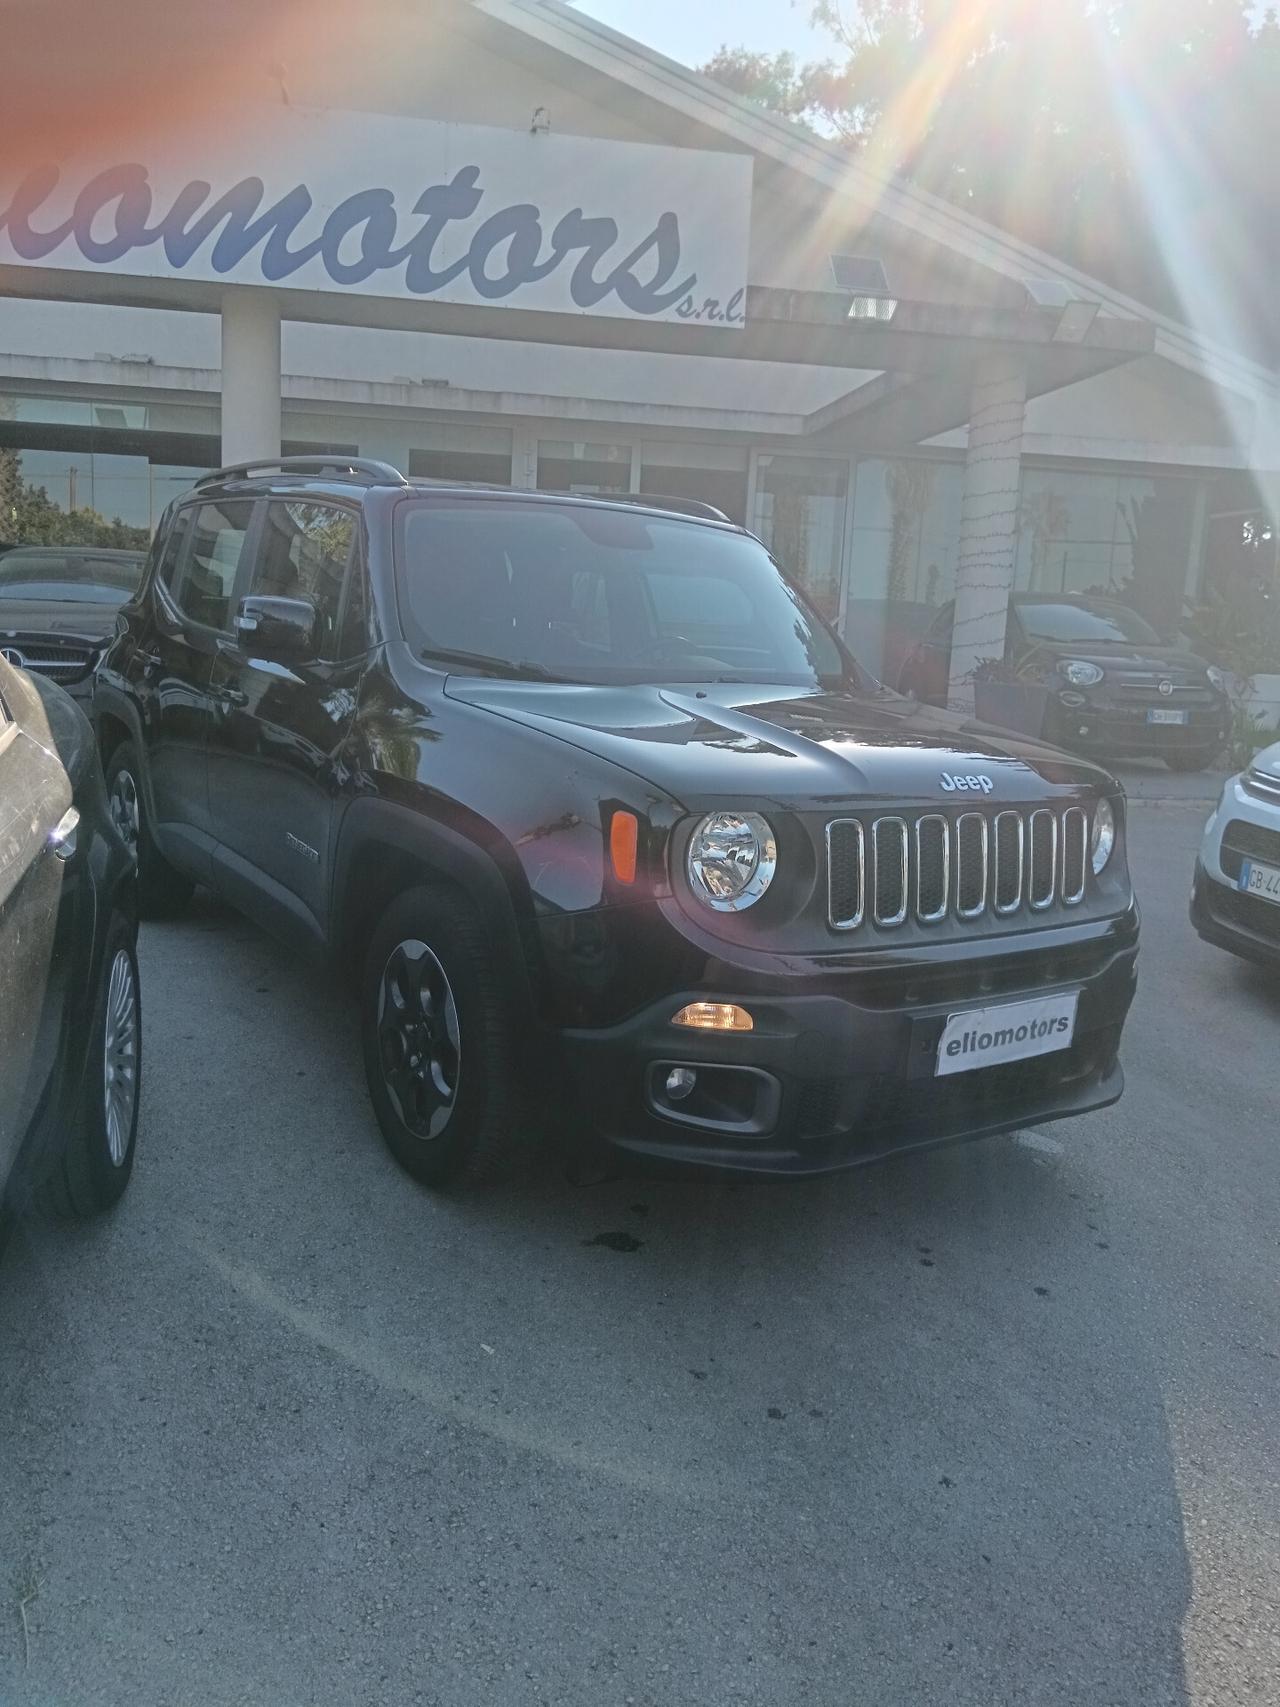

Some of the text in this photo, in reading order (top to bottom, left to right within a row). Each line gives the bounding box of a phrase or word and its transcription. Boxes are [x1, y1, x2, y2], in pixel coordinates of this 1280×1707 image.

[674, 286, 746, 323] s.r.l.
[940, 772, 994, 794] Jeep
[946, 1015, 1069, 1057] eliomotors
